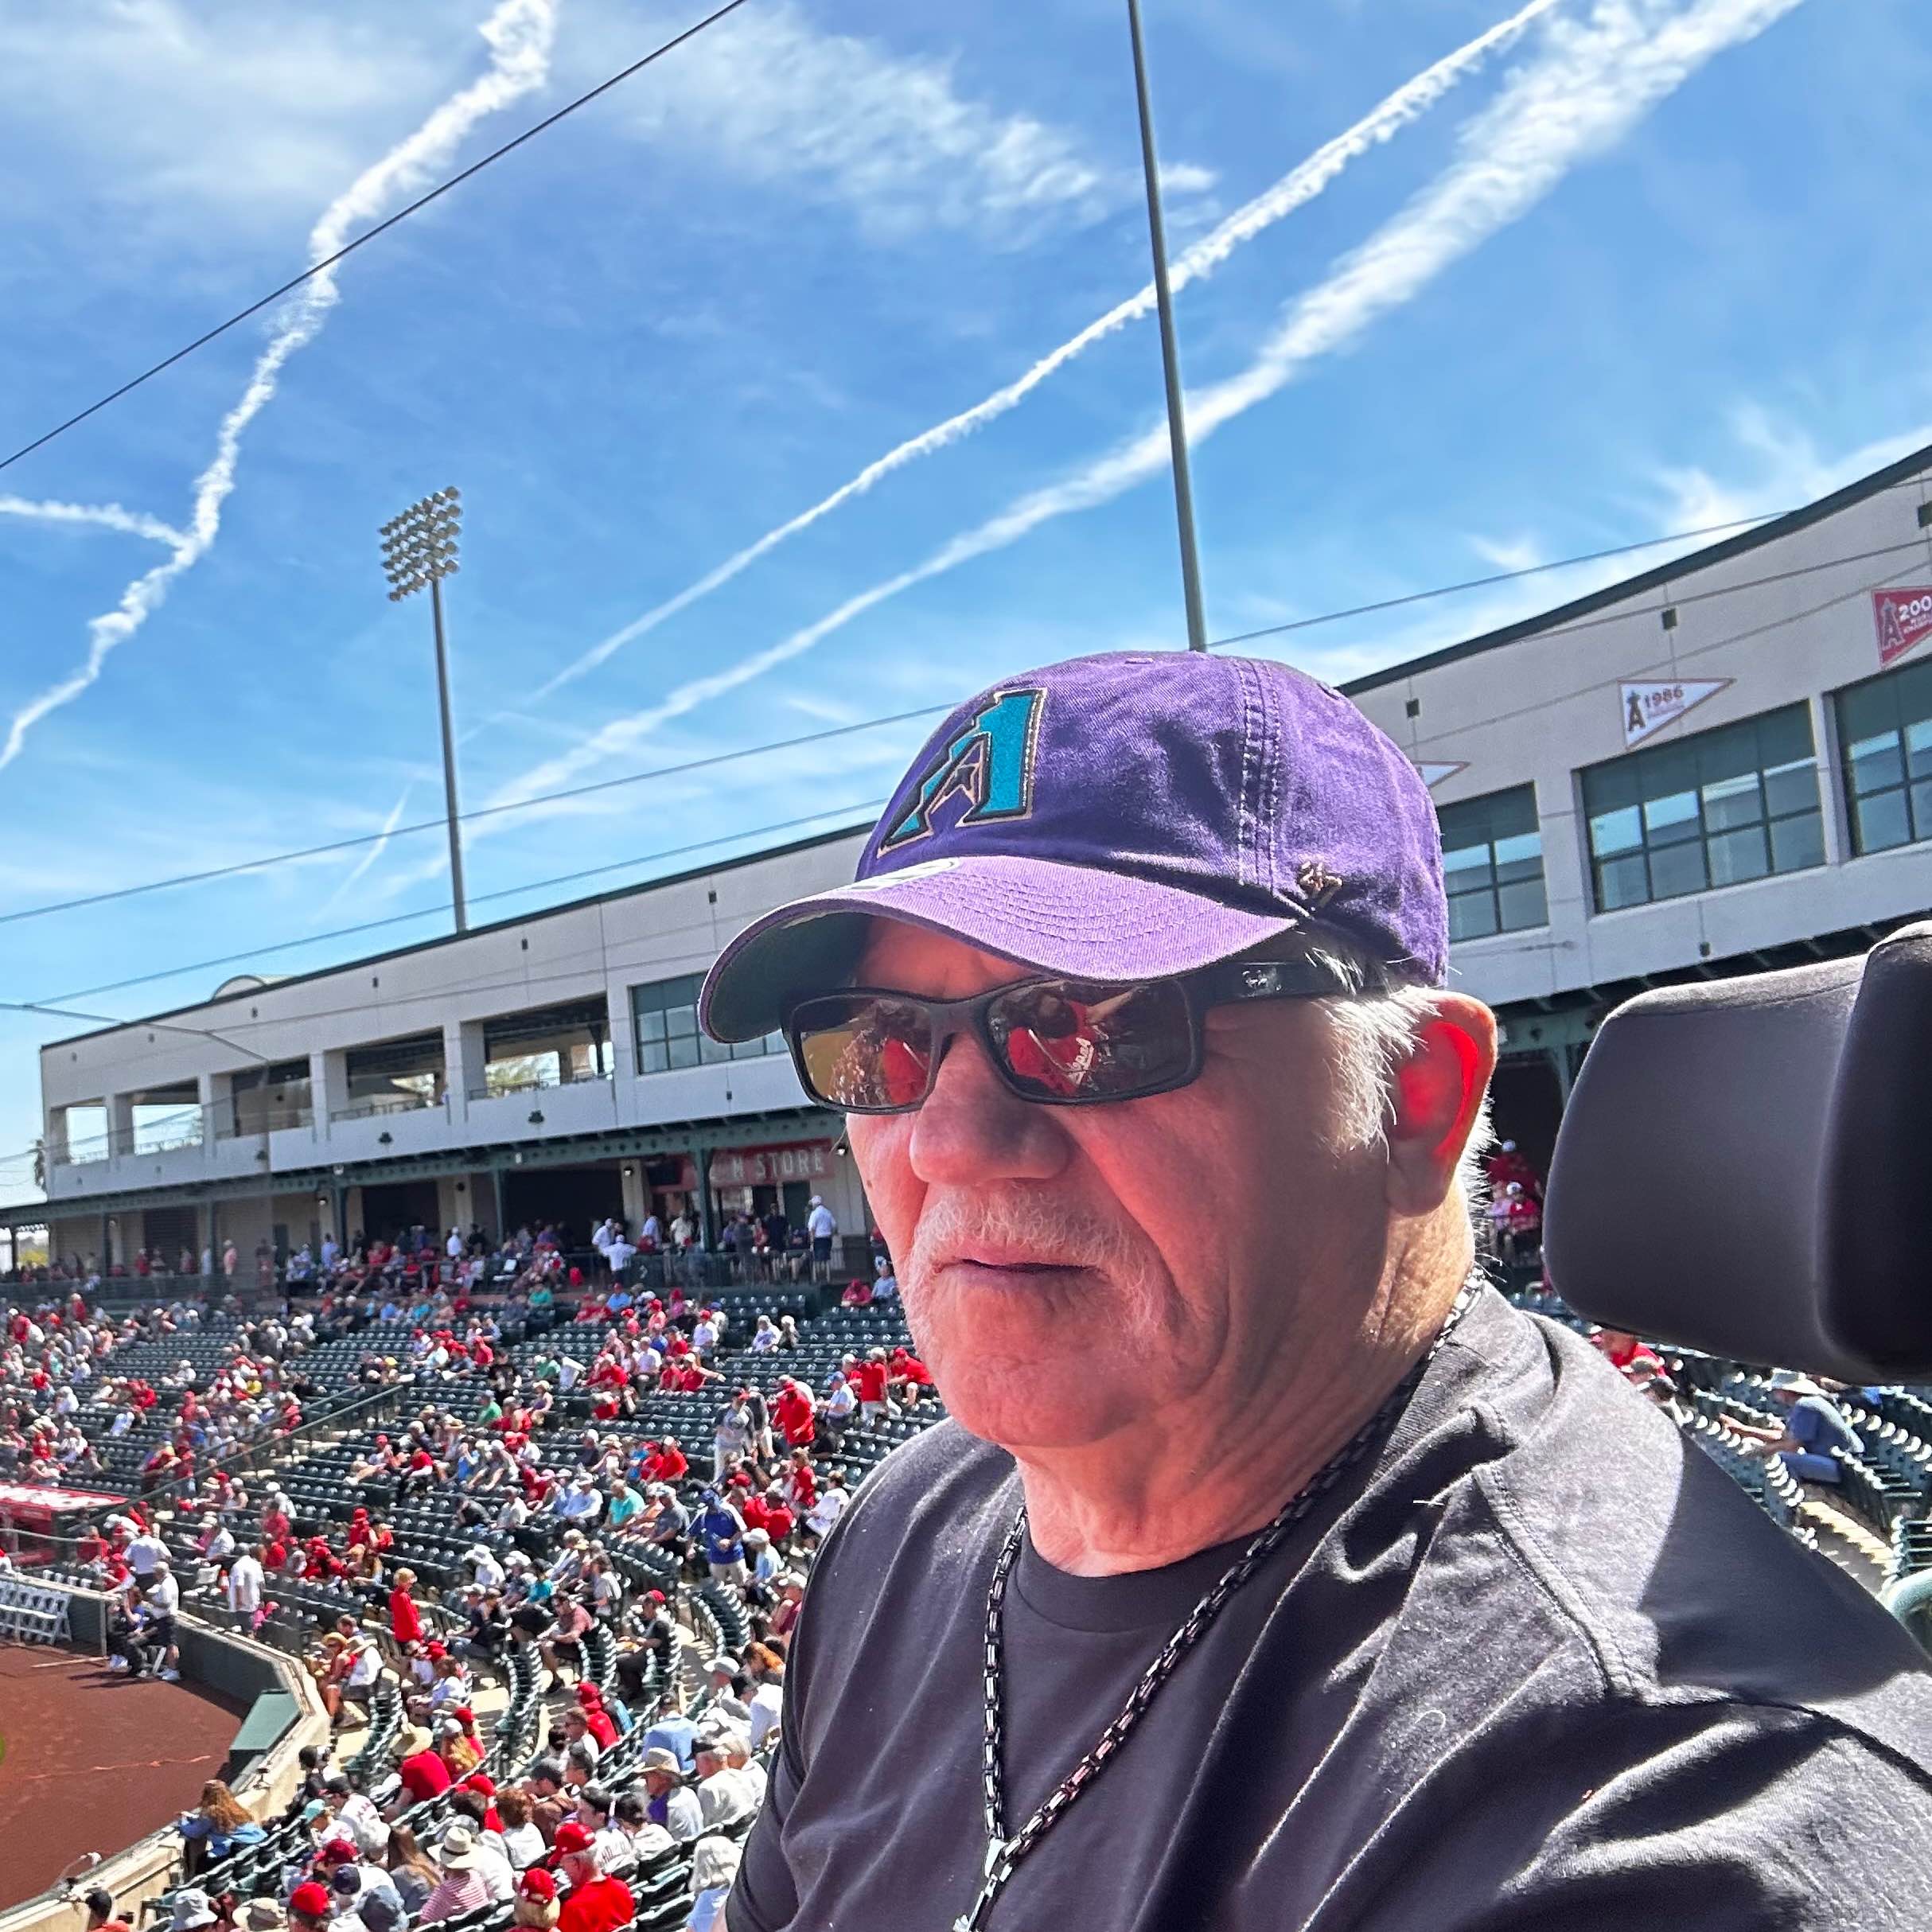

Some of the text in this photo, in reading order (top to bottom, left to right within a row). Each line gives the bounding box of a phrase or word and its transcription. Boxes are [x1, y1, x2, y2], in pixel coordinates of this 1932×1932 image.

[1626, 690, 1646, 732] A
[1644, 684, 1685, 707] 1986
[756, 1148, 824, 1179] STORE
